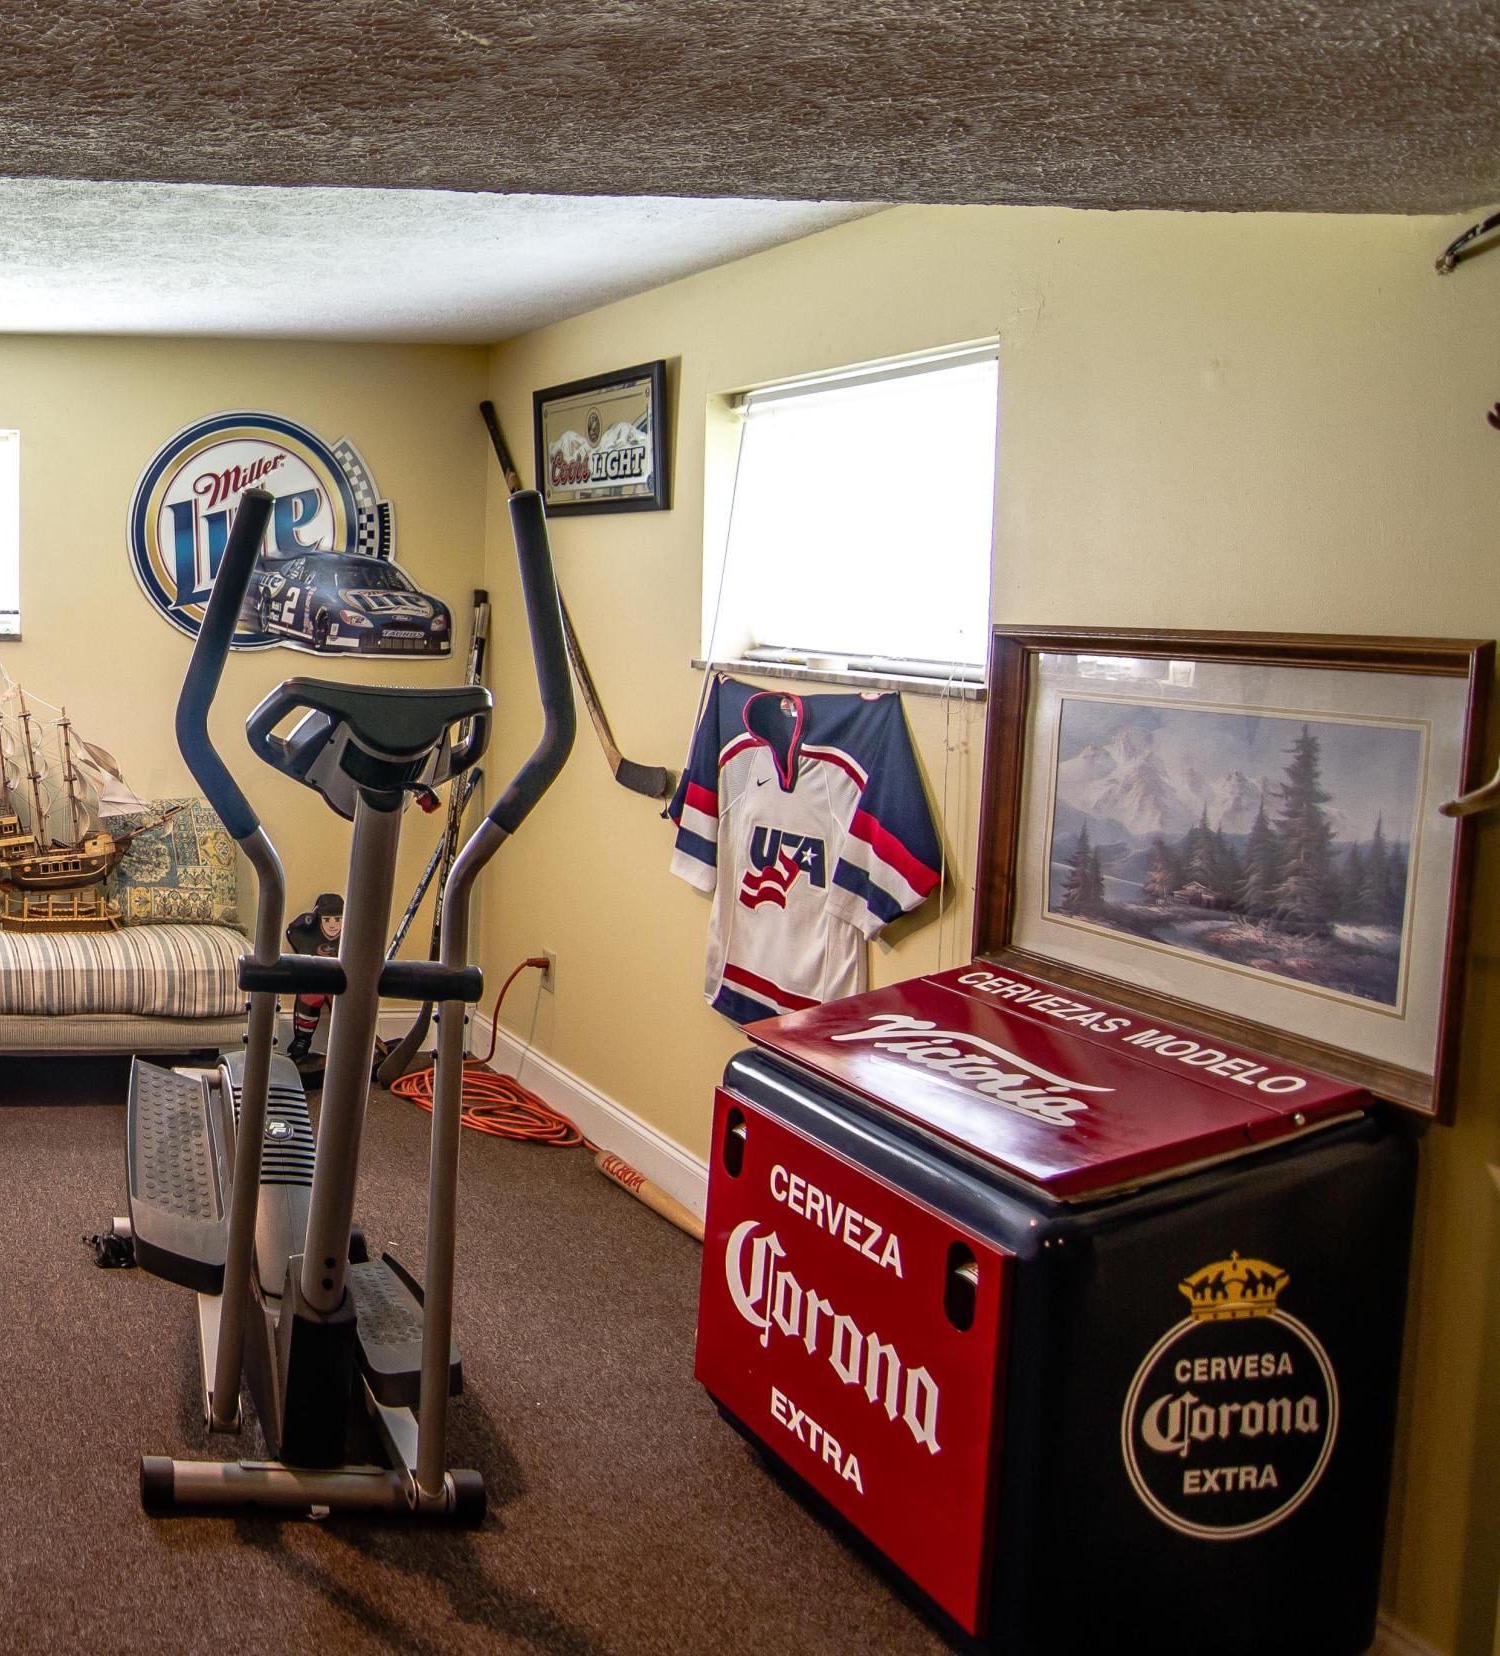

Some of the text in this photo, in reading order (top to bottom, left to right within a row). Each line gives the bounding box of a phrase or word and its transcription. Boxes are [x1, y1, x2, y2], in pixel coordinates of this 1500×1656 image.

[193, 454, 286, 508] Miller
[551, 446, 646, 486] Coors LIGHT
[164, 488, 326, 610] Lie
[281, 586, 301, 625] 2
[382, 629, 425, 638] TAURUS
[747, 826, 826, 894] USA
[958, 971, 1307, 1094] CERVEZAS MODELO
[831, 1014, 1116, 1127] Victoria
[601, 1155, 645, 1194] WORTH
[770, 1164, 904, 1279] CERVEZA
[725, 1220, 941, 1455] Corona
[1175, 1352, 1294, 1384] CERVESA
[770, 1385, 865, 1495] EXTRA
[1141, 1391, 1320, 1458] Corona
[1183, 1463, 1279, 1495] EXTRA
